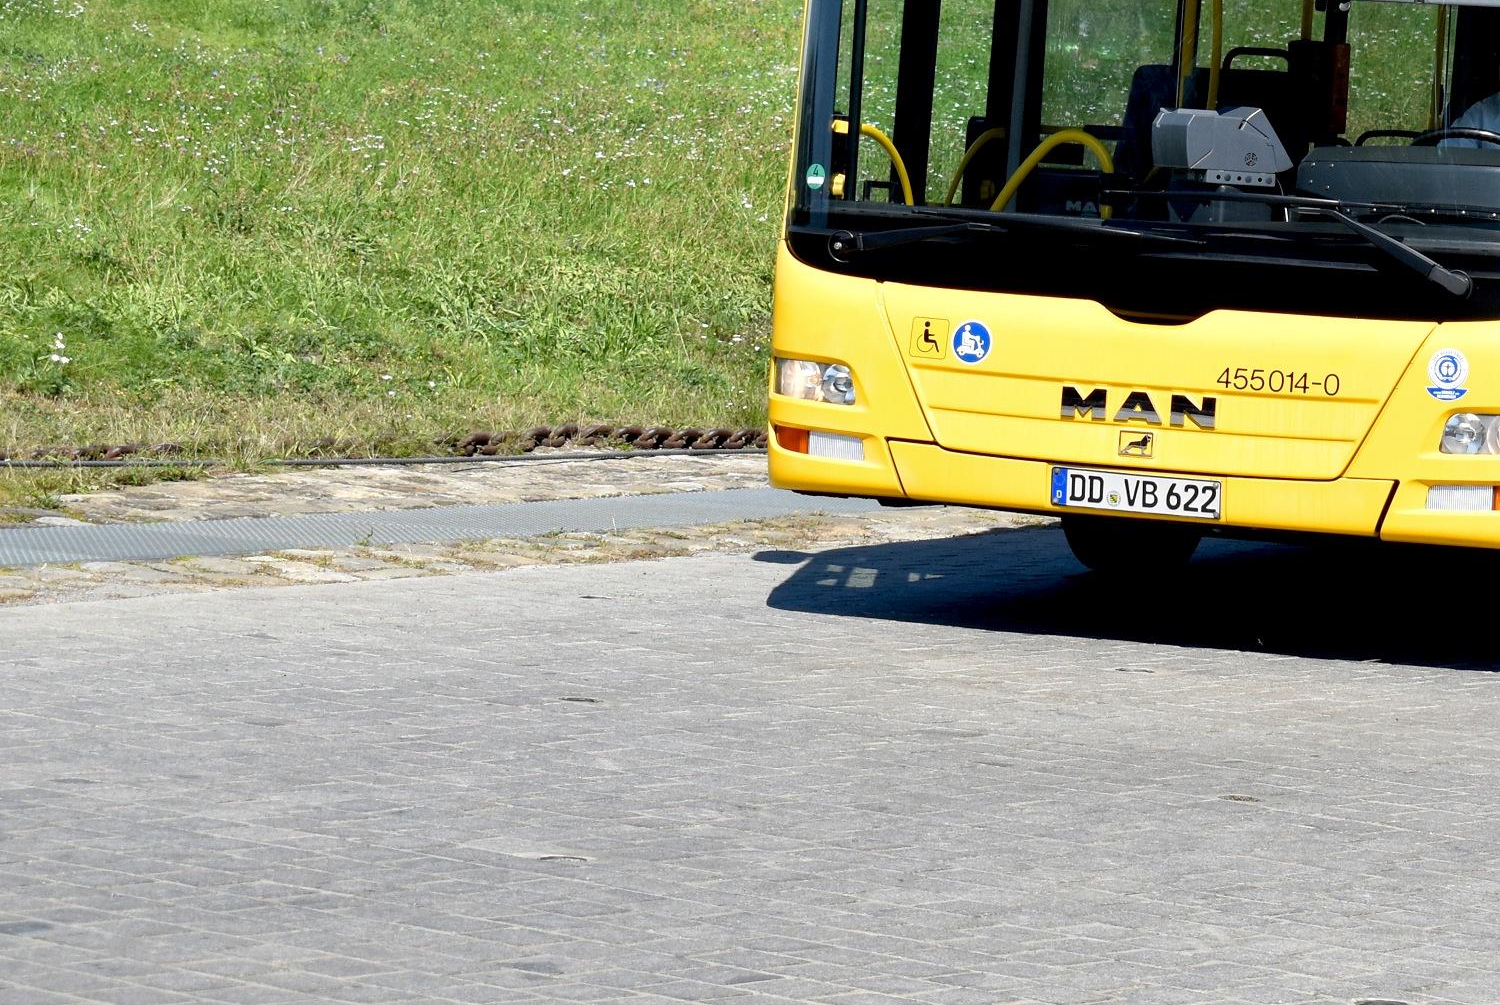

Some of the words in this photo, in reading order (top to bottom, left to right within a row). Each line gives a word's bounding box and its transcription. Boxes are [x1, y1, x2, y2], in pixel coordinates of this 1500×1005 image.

[812, 164, 819, 176] 4
[1216, 366, 1341, 396] 455014-0
[1060, 386, 1217, 431] MAN
[1056, 489, 1062, 499] D
[1069, 473, 1104, 504] DD
[1124, 478, 1159, 509] VB
[1166, 483, 1218, 514] 622
